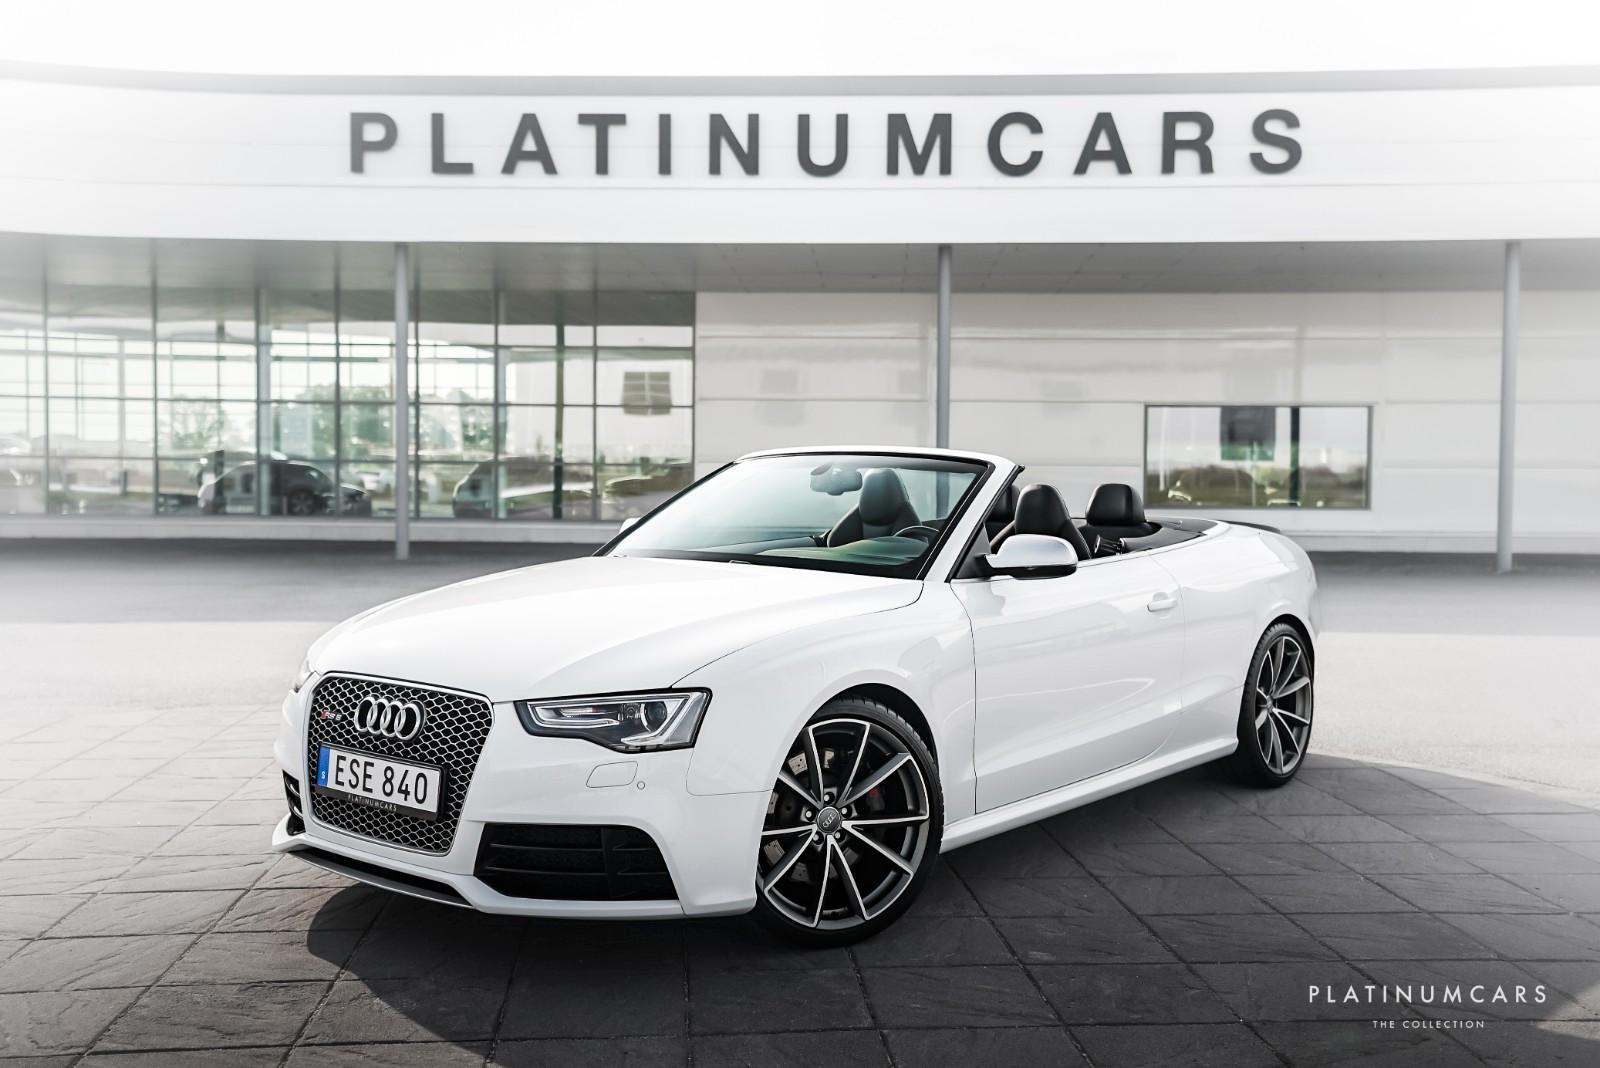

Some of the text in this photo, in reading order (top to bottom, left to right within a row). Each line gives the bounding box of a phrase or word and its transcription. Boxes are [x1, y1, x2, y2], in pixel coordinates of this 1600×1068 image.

[350, 108, 1304, 177] PLATINUMCARS
[320, 770, 327, 780] S
[334, 754, 428, 804] ESE 840
